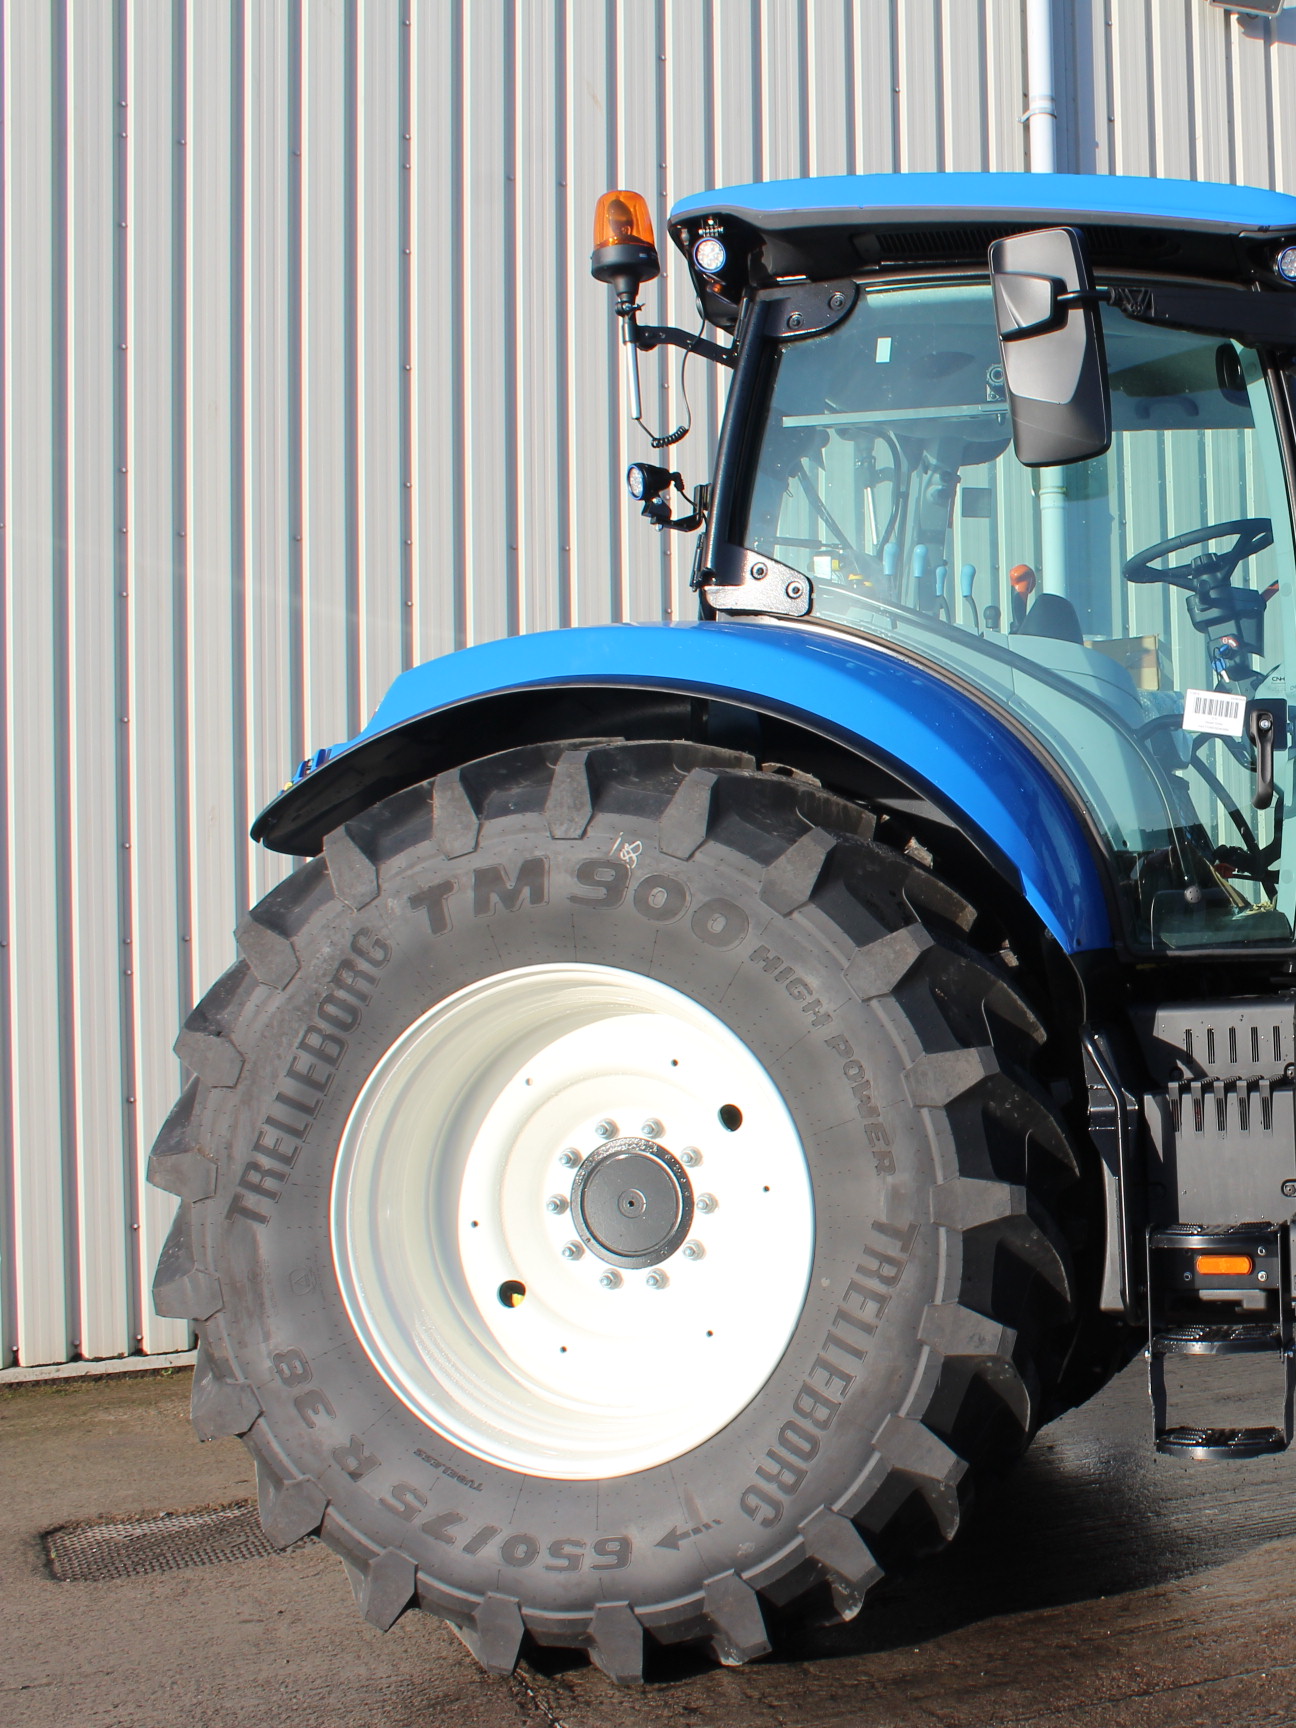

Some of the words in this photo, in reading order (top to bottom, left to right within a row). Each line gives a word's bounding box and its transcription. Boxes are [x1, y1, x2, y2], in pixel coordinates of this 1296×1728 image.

[408, 855, 550, 937] TM
[568, 858, 750, 952] 900
[225, 926, 393, 1228] TRELLEBORG
[749, 944, 834, 1030] HIGH
[824, 1033, 897, 1177] POWER
[272, 1346, 337, 1429] 38
[740, 1218, 922, 1530] TRELLEBORG
[331, 1434, 383, 1483] R
[413, 1447, 484, 1493] TUBELESS
[379, 1481, 633, 1573] 650/75
